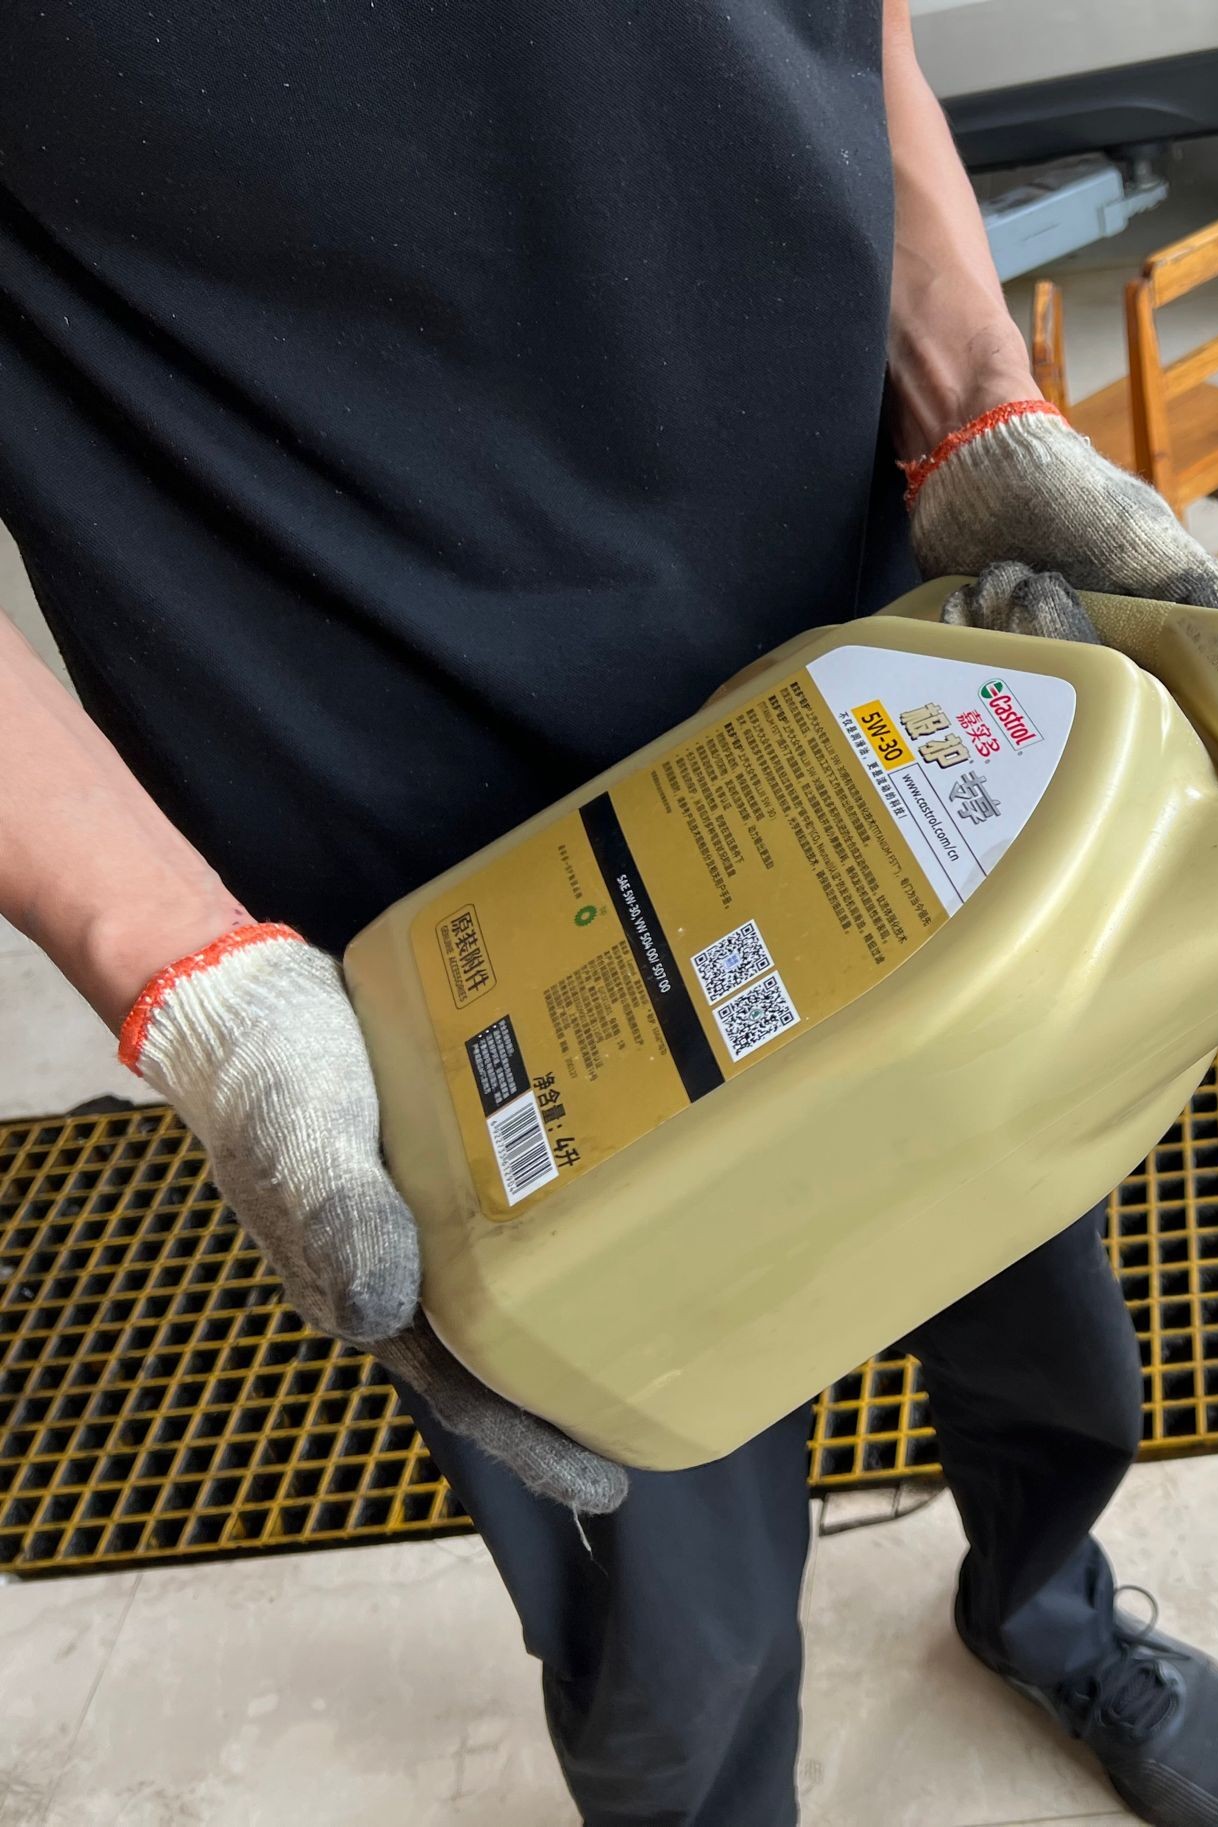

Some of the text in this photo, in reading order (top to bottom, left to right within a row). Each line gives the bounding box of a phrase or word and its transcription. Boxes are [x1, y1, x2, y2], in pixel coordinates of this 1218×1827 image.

[861, 711, 903, 762] 5W-30
[956, 709, 1001, 757] 嘉实多
[989, 695, 1037, 746] Castrol
[900, 702, 1001, 825] 极护 专享
[901, 774, 960, 862] www.castrol.com/cn
[616, 873, 630, 892] SAE
[621, 888, 642, 921] 5W-30,
[633, 916, 647, 935] VW
[639, 931, 654, 951] 504
[450, 911, 490, 992] 原装附件
[651, 961, 666, 982] 507
[657, 977, 671, 994] 00
